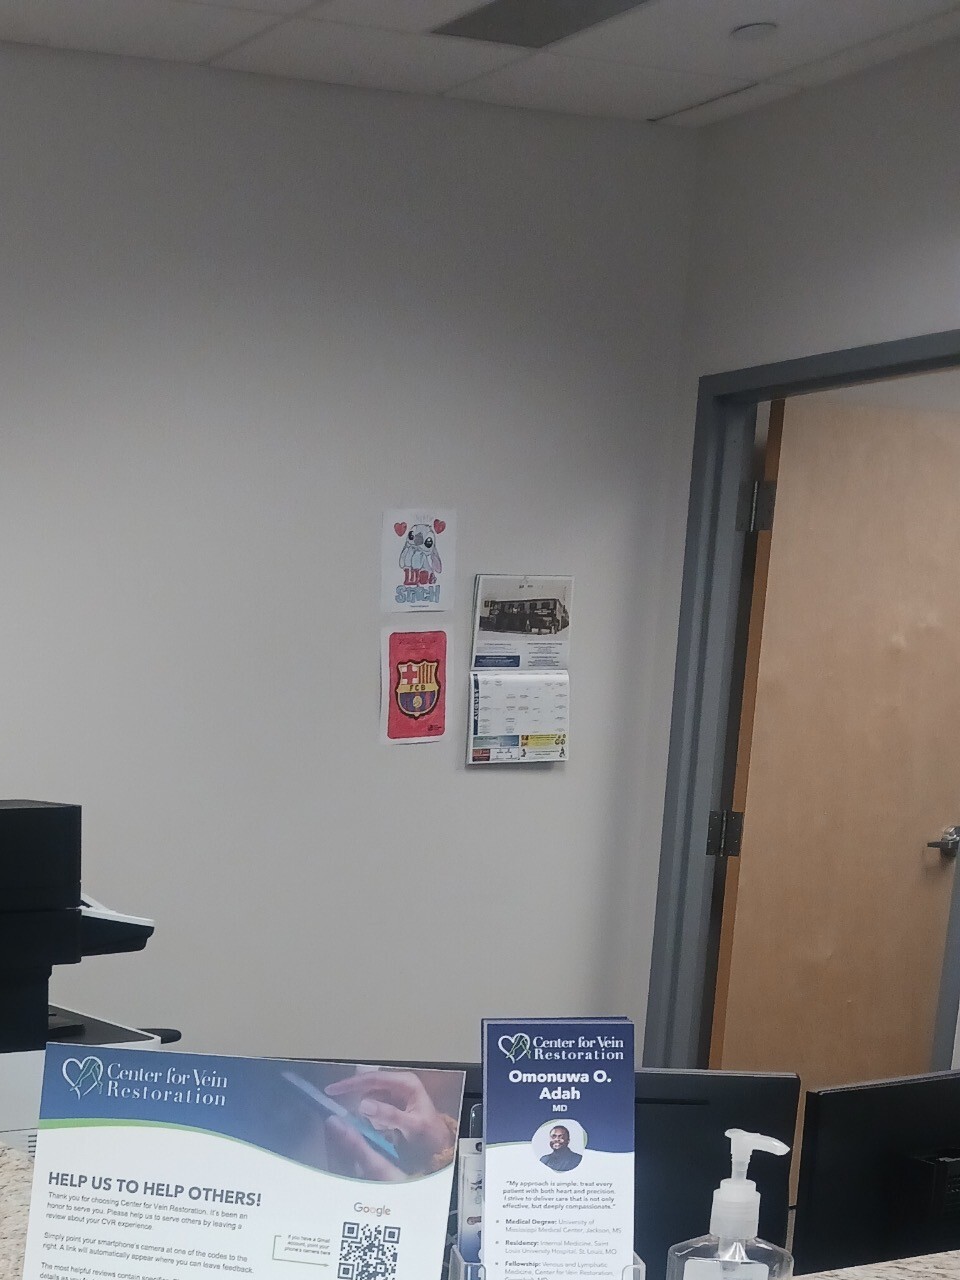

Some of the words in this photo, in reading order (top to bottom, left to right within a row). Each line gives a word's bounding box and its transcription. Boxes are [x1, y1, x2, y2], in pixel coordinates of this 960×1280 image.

[533, 1036, 575, 1048] Center
[578, 1036, 596, 1048] for
[597, 1036, 624, 1048] Vein
[534, 1048, 624, 1060] Restoration
[107, 1063, 162, 1082] Center
[166, 1067, 190, 1085] for
[193, 1069, 228, 1088] Vein
[508, 1070, 589, 1083] Omonuwa
[593, 1070, 612, 1083] O.
[107, 1081, 226, 1106] Restoration
[540, 1087, 580, 1100] Adah
[48, 1172, 87, 1189] HELP
[90, 1176, 112, 1191] US
[115, 1178, 139, 1194] TO
[143, 1181, 184, 1199] HELP
[188, 1186, 261, 1206] OTHERS!
[48, 1191, 67, 1200] Thank
[90, 1196, 119, 1207] choosing
[120, 1199, 142, 1207] Center
[220, 1209, 238, 1217] been
[354, 1202, 391, 1217] Google
[45, 1212, 66, 1220] review
[67, 1214, 85, 1222] about
[100, 1218, 116, 1226] CVR
[46, 1202, 65, 1210] honor
[106, 1208, 128, 1217] Please
[129, 1210, 144, 1220] help
[180, 1216, 202, 1224] others
[202, 1218, 211, 1227] by
[212, 1219, 236, 1230] leaving
[43, 1231, 64, 1242] Simply
[65, 1234, 81, 1244] point
[96, 1238, 140, 1250] smartphone's
[207, 1250, 228, 1259] codes
[88, 1247, 130, 1260] automatically
[130, 1254, 153, 1263] appear
[154, 1255, 174, 1264] where
[202, 1261, 221, 1269] leave
[221, 1263, 253, 1273] feedback.
[39, 1272, 60, 1280] details
[53, 1263, 69, 1271] most
[69, 1265, 91, 1276] helpful
[91, 1268, 116, 1277] reviews
[116, 1271, 141, 1280] contain
